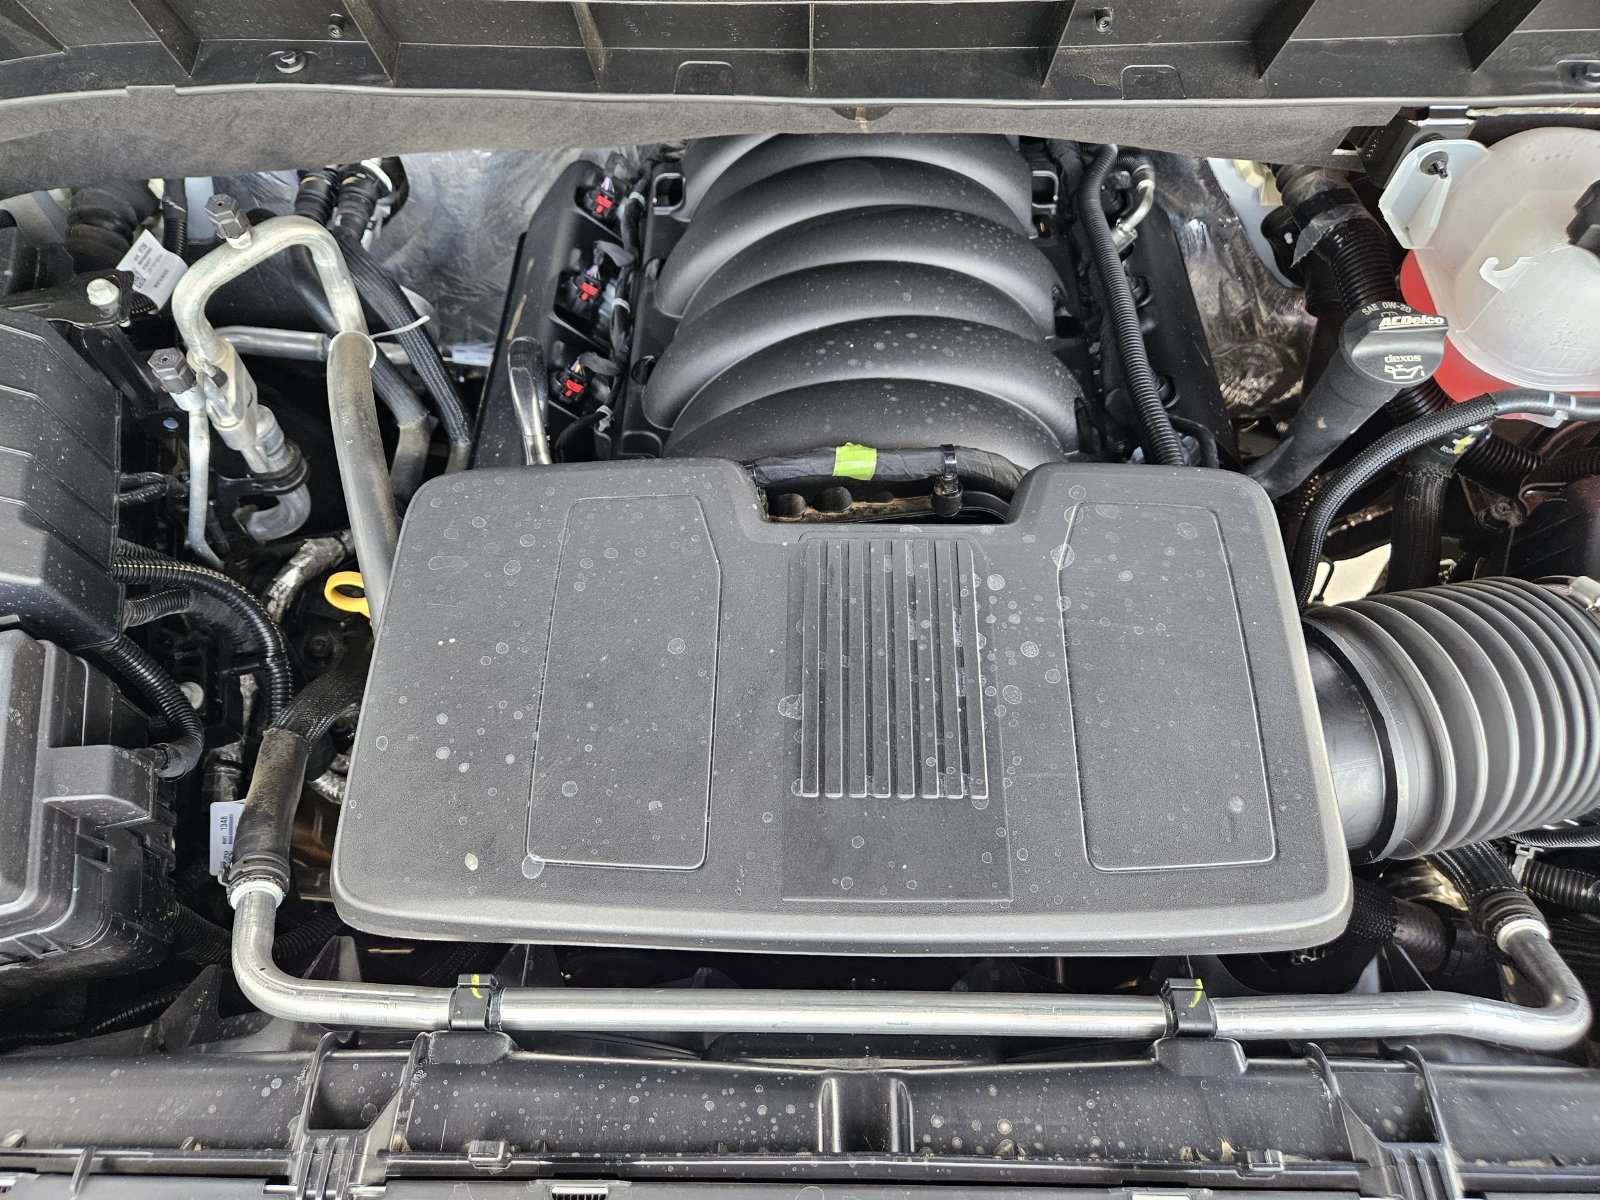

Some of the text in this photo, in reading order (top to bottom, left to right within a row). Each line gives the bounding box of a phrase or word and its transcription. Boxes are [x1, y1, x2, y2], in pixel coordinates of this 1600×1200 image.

[1361, 301, 1412, 316] SAE 0W-20
[1379, 314, 1445, 328] ACDelco
[1384, 354, 1422, 363] dexos
